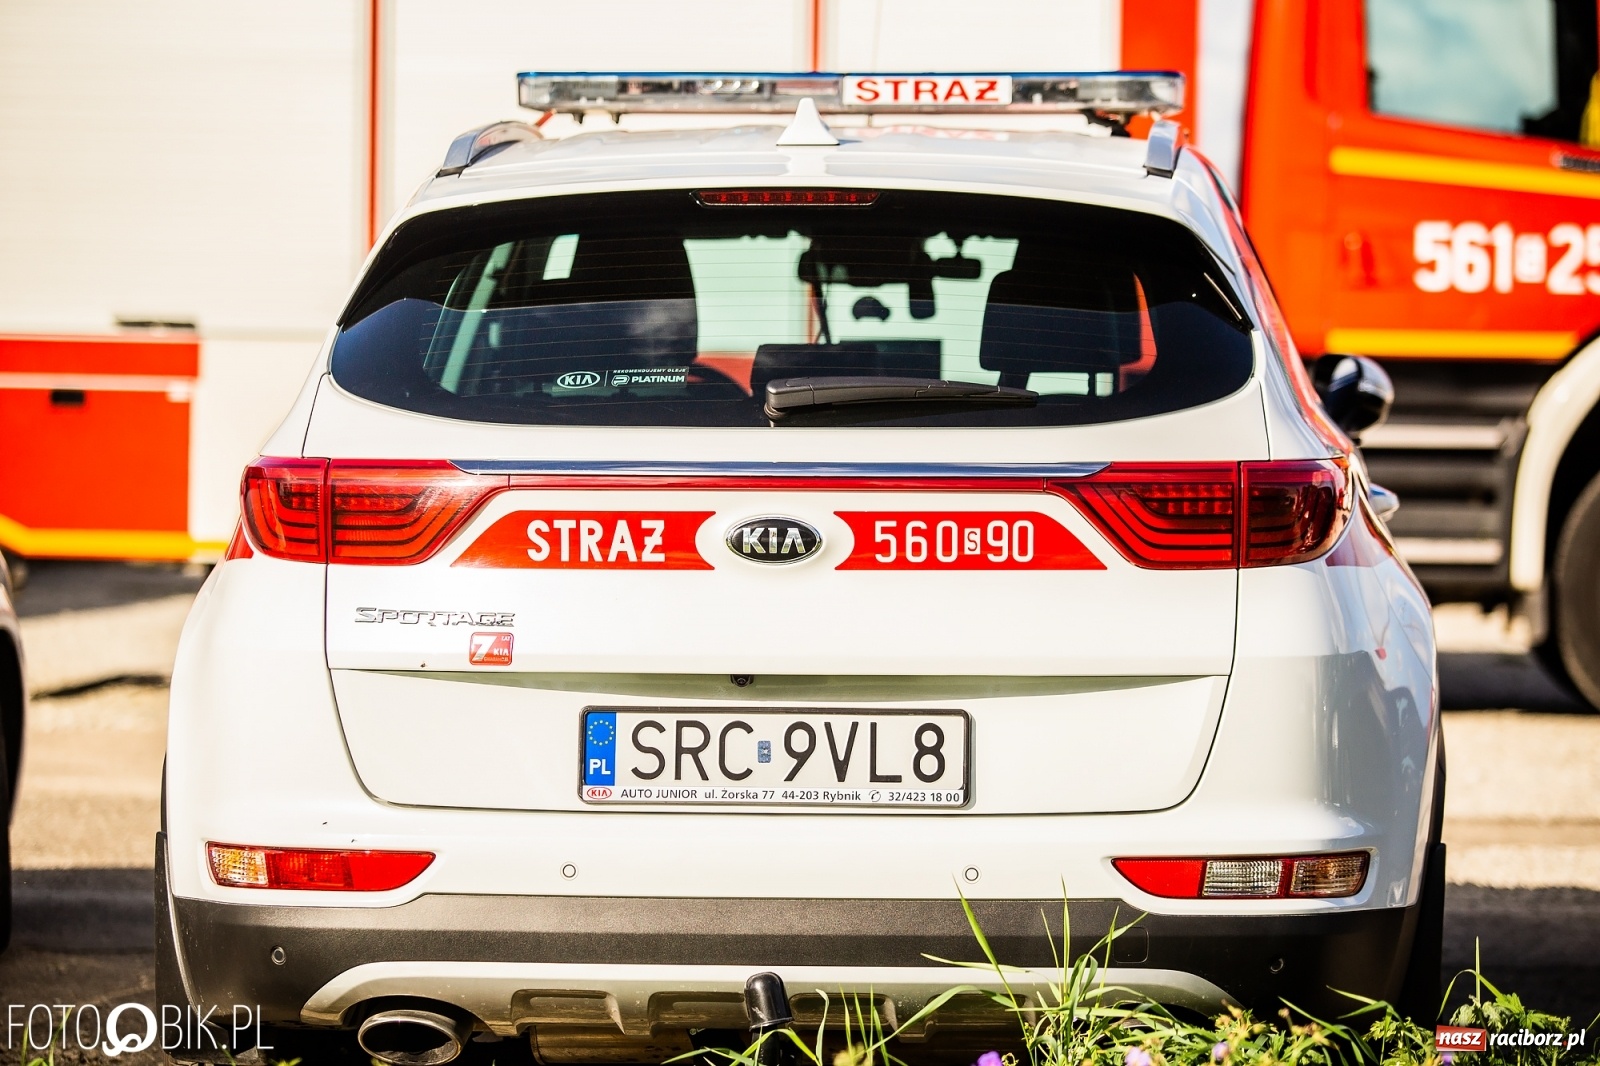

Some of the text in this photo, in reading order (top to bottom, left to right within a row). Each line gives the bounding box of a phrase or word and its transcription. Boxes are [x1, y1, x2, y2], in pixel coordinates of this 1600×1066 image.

[564, 375, 592, 386] KIA
[631, 375, 685, 383] PLATINUM
[743, 527, 806, 554] KIA
[354, 606, 516, 628] SPORTAGE
[493, 647, 509, 656] KIA
[630, 720, 946, 784] SRC 9VL8
[588, 757, 611, 775] PL
[620, 787, 960, 803] AUTO JUNIOR ul. Żorska 77 44-203 Rybnik 32/423 18 00
